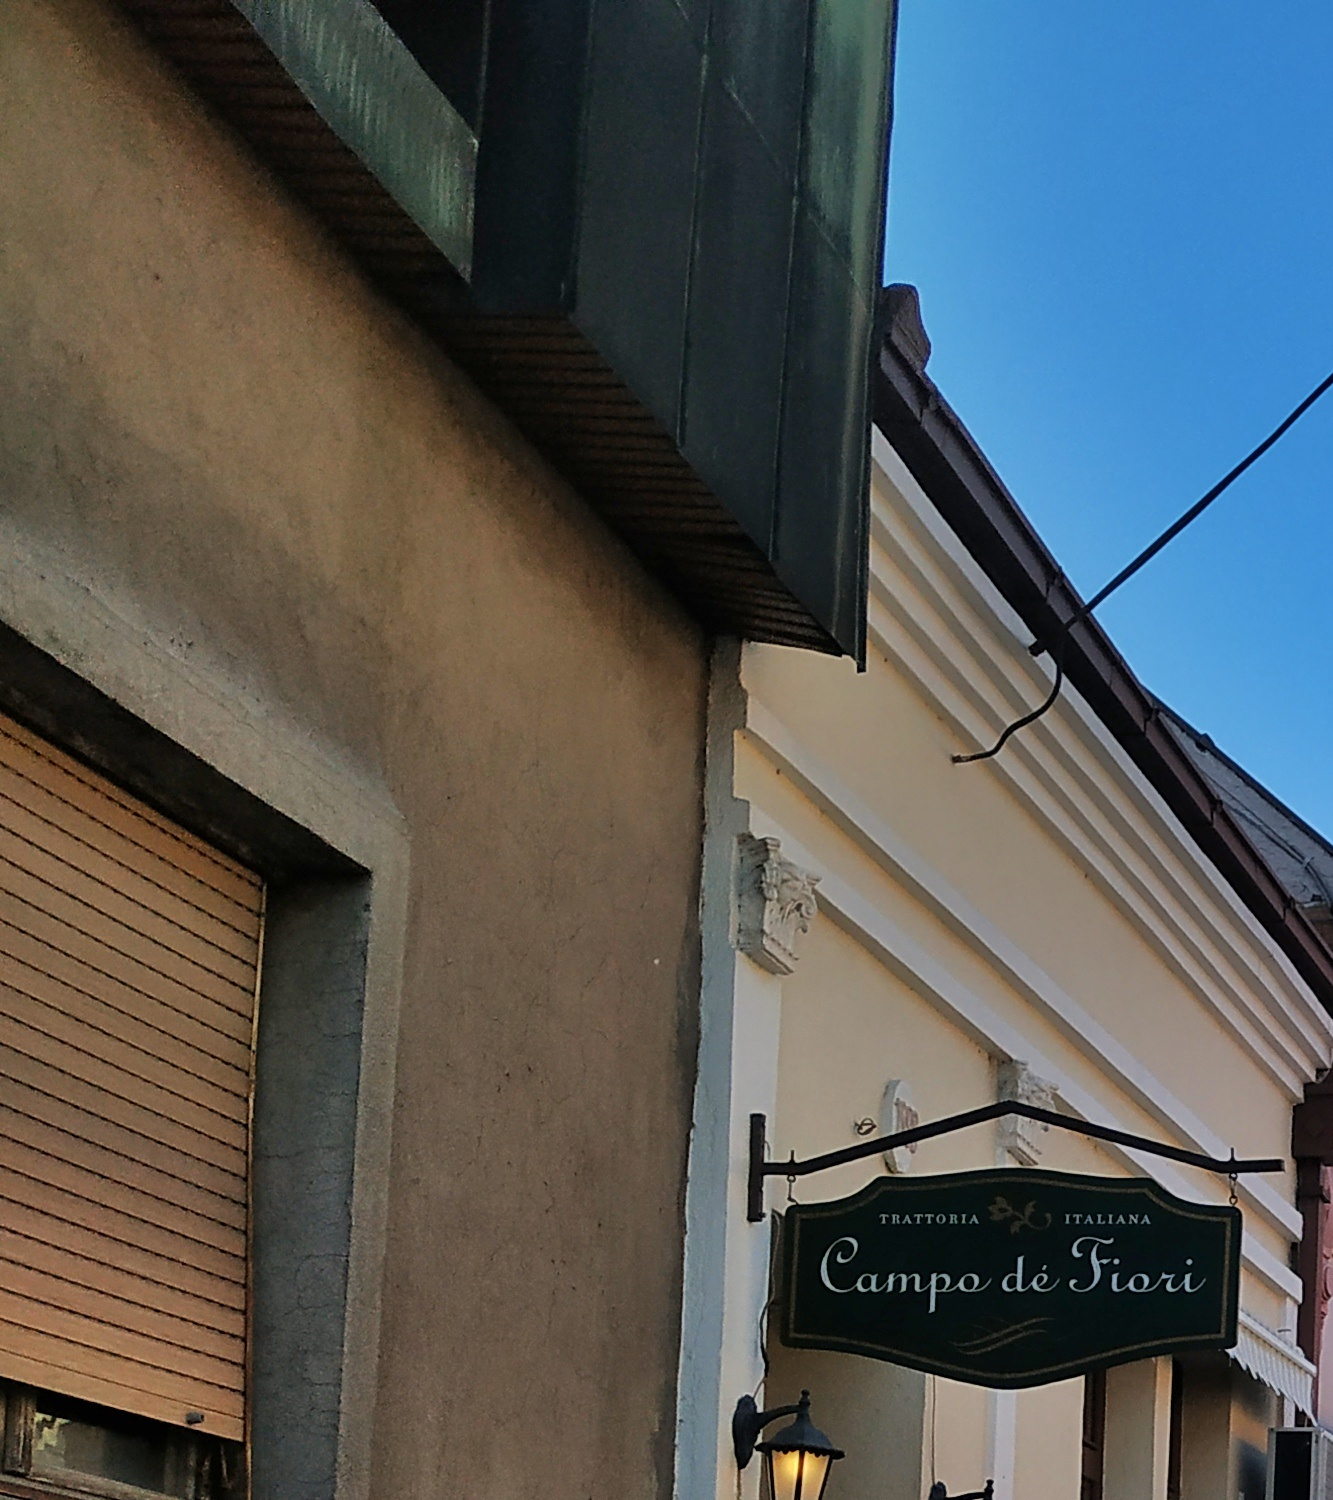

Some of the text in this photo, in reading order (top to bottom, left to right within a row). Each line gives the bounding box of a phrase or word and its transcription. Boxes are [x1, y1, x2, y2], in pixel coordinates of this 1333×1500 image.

[878, 1213, 1152, 1225] TRATTORIA ITALIANA
[820, 1236, 1207, 1314] Campo dé Fiori
